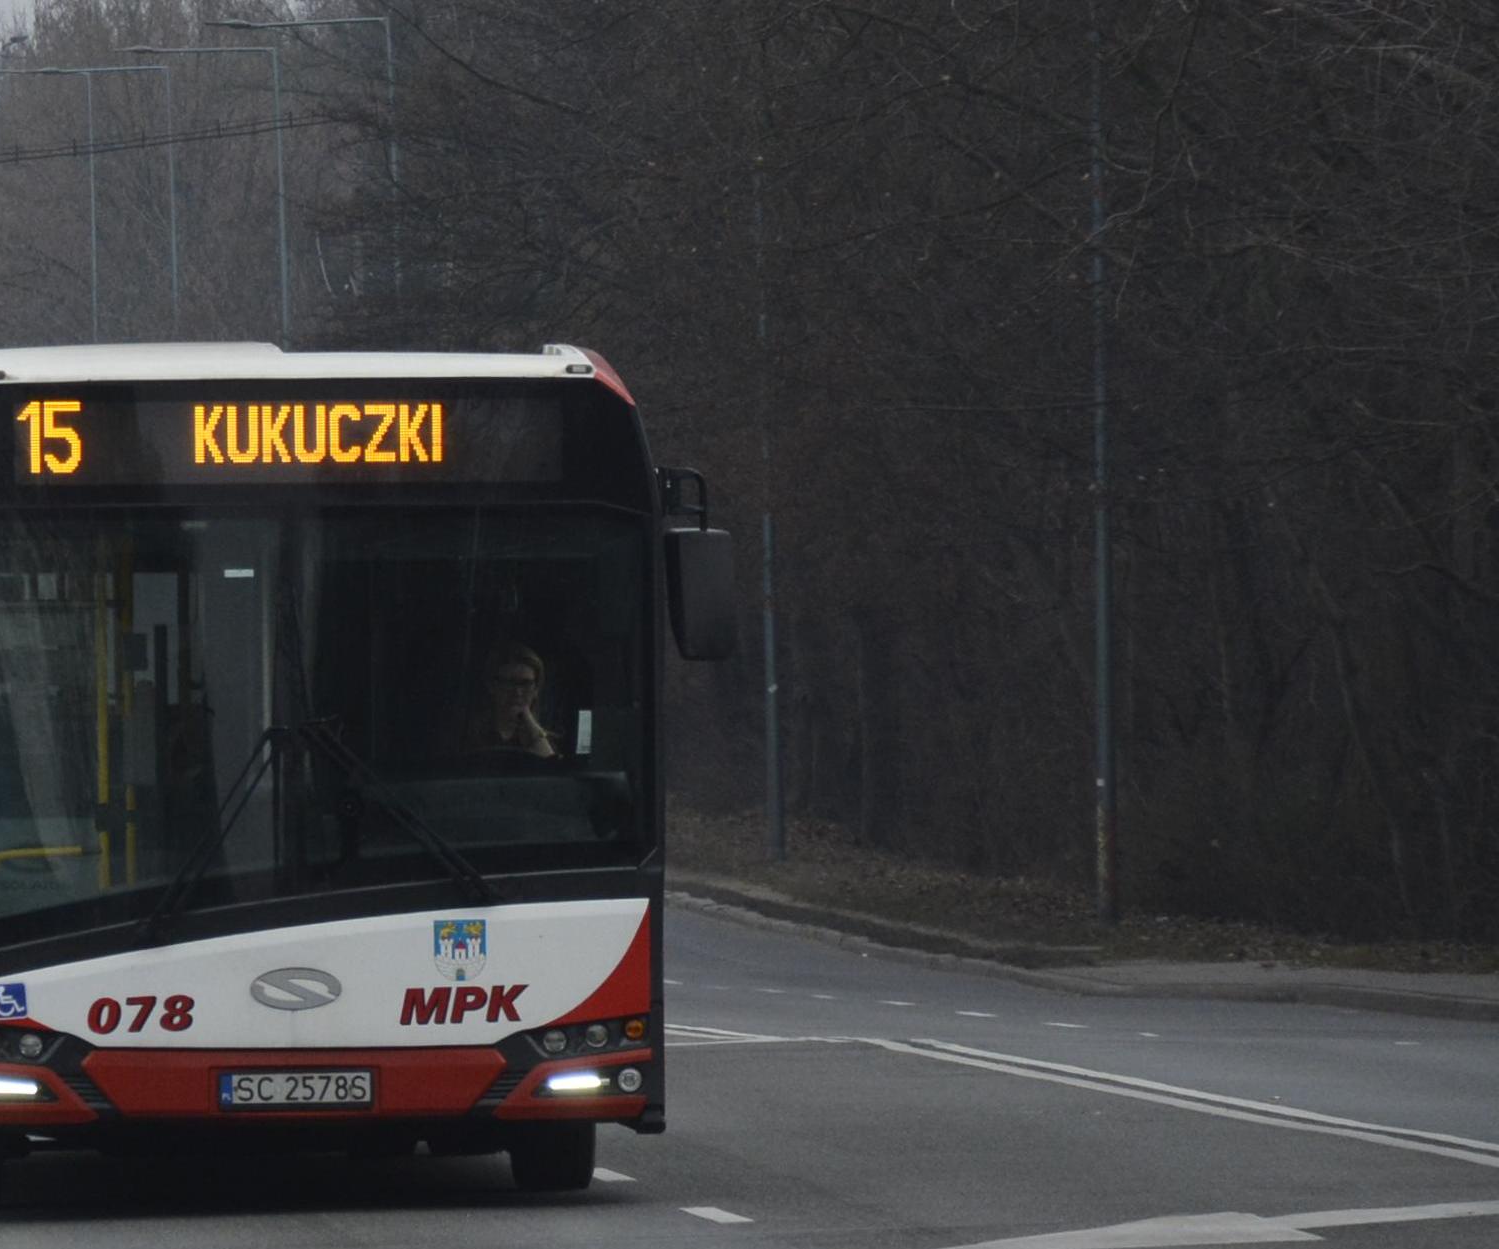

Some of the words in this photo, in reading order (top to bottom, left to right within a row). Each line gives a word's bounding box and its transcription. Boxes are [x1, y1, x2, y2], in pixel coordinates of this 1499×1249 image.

[16, 401, 82, 474] 15
[194, 403, 443, 463] KUKUCZKI
[87, 994, 195, 1035] 078
[399, 983, 530, 1026] MPK
[236, 1076, 274, 1102] SC
[284, 1075, 367, 1101] 2578S
